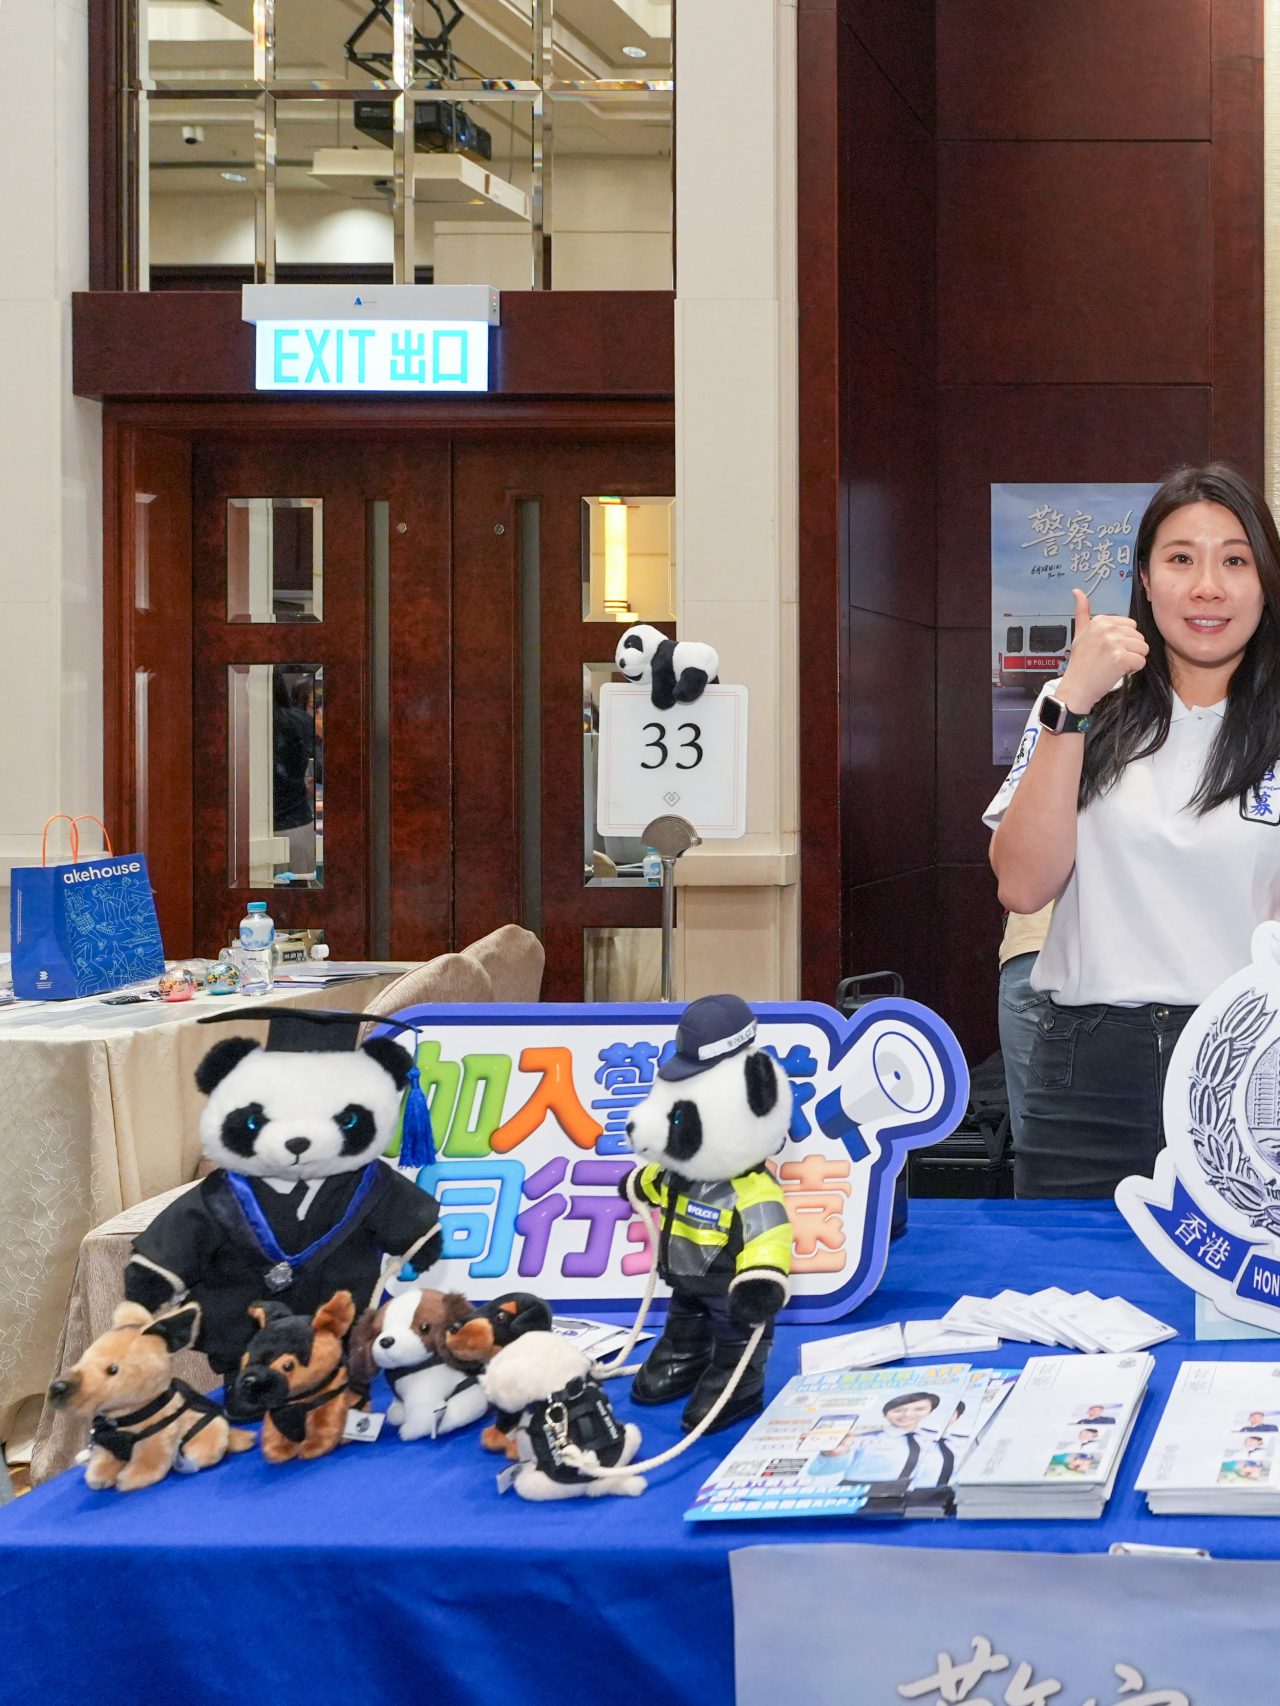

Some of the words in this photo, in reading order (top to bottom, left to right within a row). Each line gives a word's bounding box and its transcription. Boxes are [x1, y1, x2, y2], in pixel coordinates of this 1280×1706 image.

[274, 329, 375, 383] EXIT
[390, 329, 468, 384] 出口
[640, 722, 703, 770] 33
[1174, 1211, 1232, 1271] 香港
